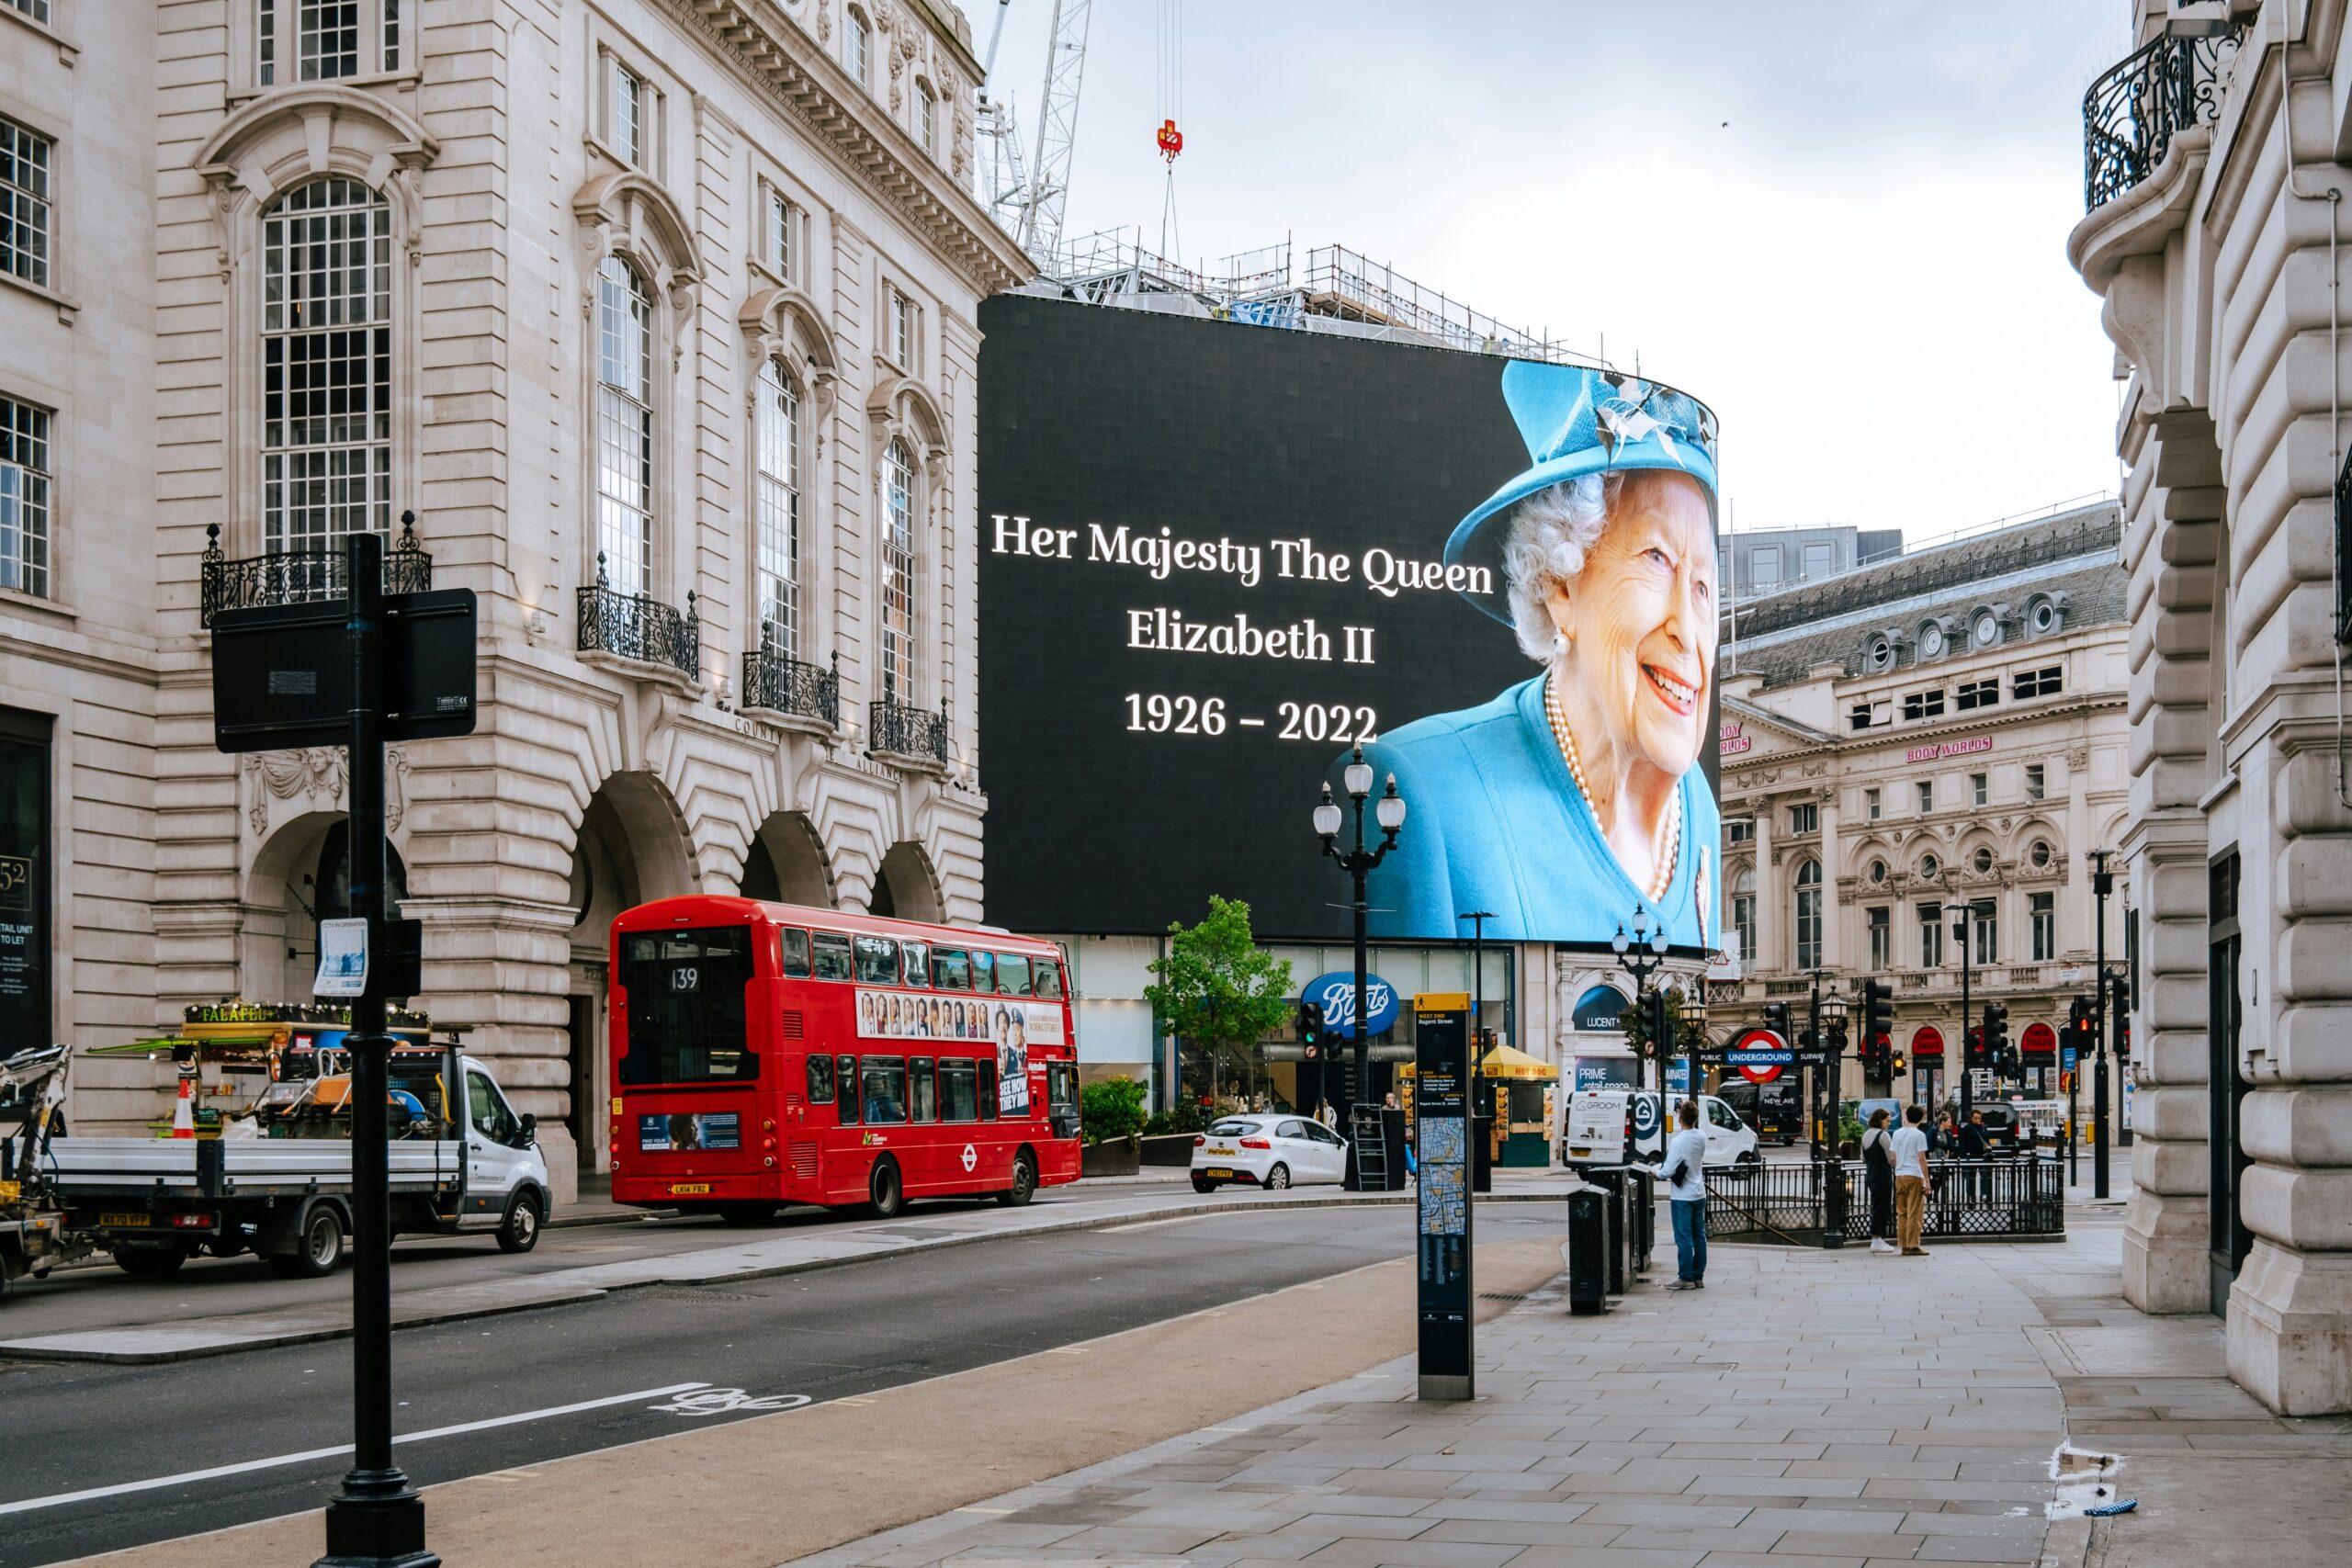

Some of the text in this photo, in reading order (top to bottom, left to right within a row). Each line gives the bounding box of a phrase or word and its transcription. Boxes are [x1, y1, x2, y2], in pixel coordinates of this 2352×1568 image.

[991, 514, 1494, 597] Her Majesty The Queen
[1126, 607, 1375, 664] Elizabeth II
[1125, 693, 1227, 736] 1926
[1278, 701, 1377, 744] 2022
[1907, 738, 1991, 761] BODY WORLDS
[17, 925, 34, 934] UNIT
[1, 934, 25, 944] TO LET
[673, 967, 697, 989] 139
[1587, 1018, 1616, 1027] LUCENT
[1728, 1053, 1792, 1062] UNDERGROUND
[1800, 1053, 1826, 1061] SUBWAY
[1515, 1067, 1547, 1076] HOT DOG
[1579, 1068, 1606, 1079] PRIME
[1000, 1077, 1028, 1101] SEE HOW
[1000, 1094, 1017, 1111] THEY
